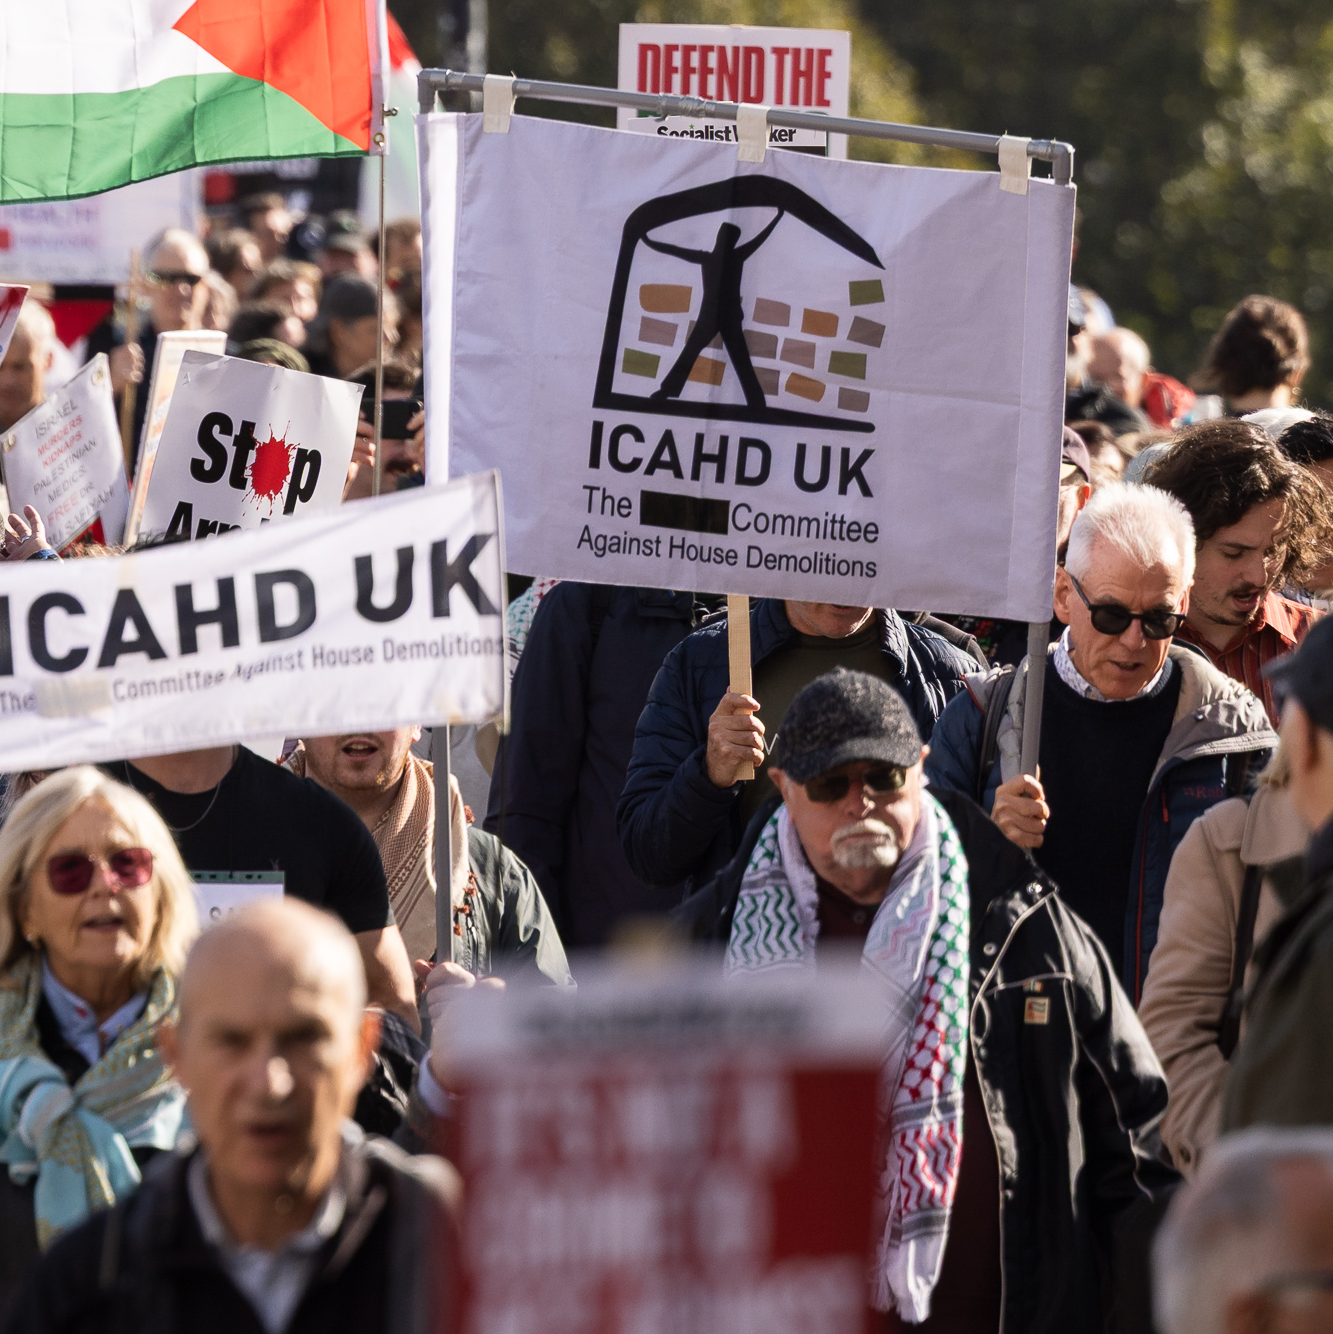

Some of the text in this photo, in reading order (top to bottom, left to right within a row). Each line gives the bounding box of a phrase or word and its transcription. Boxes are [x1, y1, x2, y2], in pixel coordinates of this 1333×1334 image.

[638, 43, 833, 107] DEFEND THE
[657, 124, 731, 142] Socialist
[35, 399, 78, 440] ISRAEL
[37, 414, 84, 456] MURDERS
[189, 411, 323, 516] Stop
[588, 420, 876, 498] ICAHD UK
[582, 485, 879, 544] The Committee
[353, 533, 503, 623] UK
[577, 525, 877, 579] Against House Demolitions
[113, 668, 225, 701] Committee
[229, 651, 304, 682] Against
[312, 643, 374, 669] House
[383, 633, 503, 663] Demolitions
